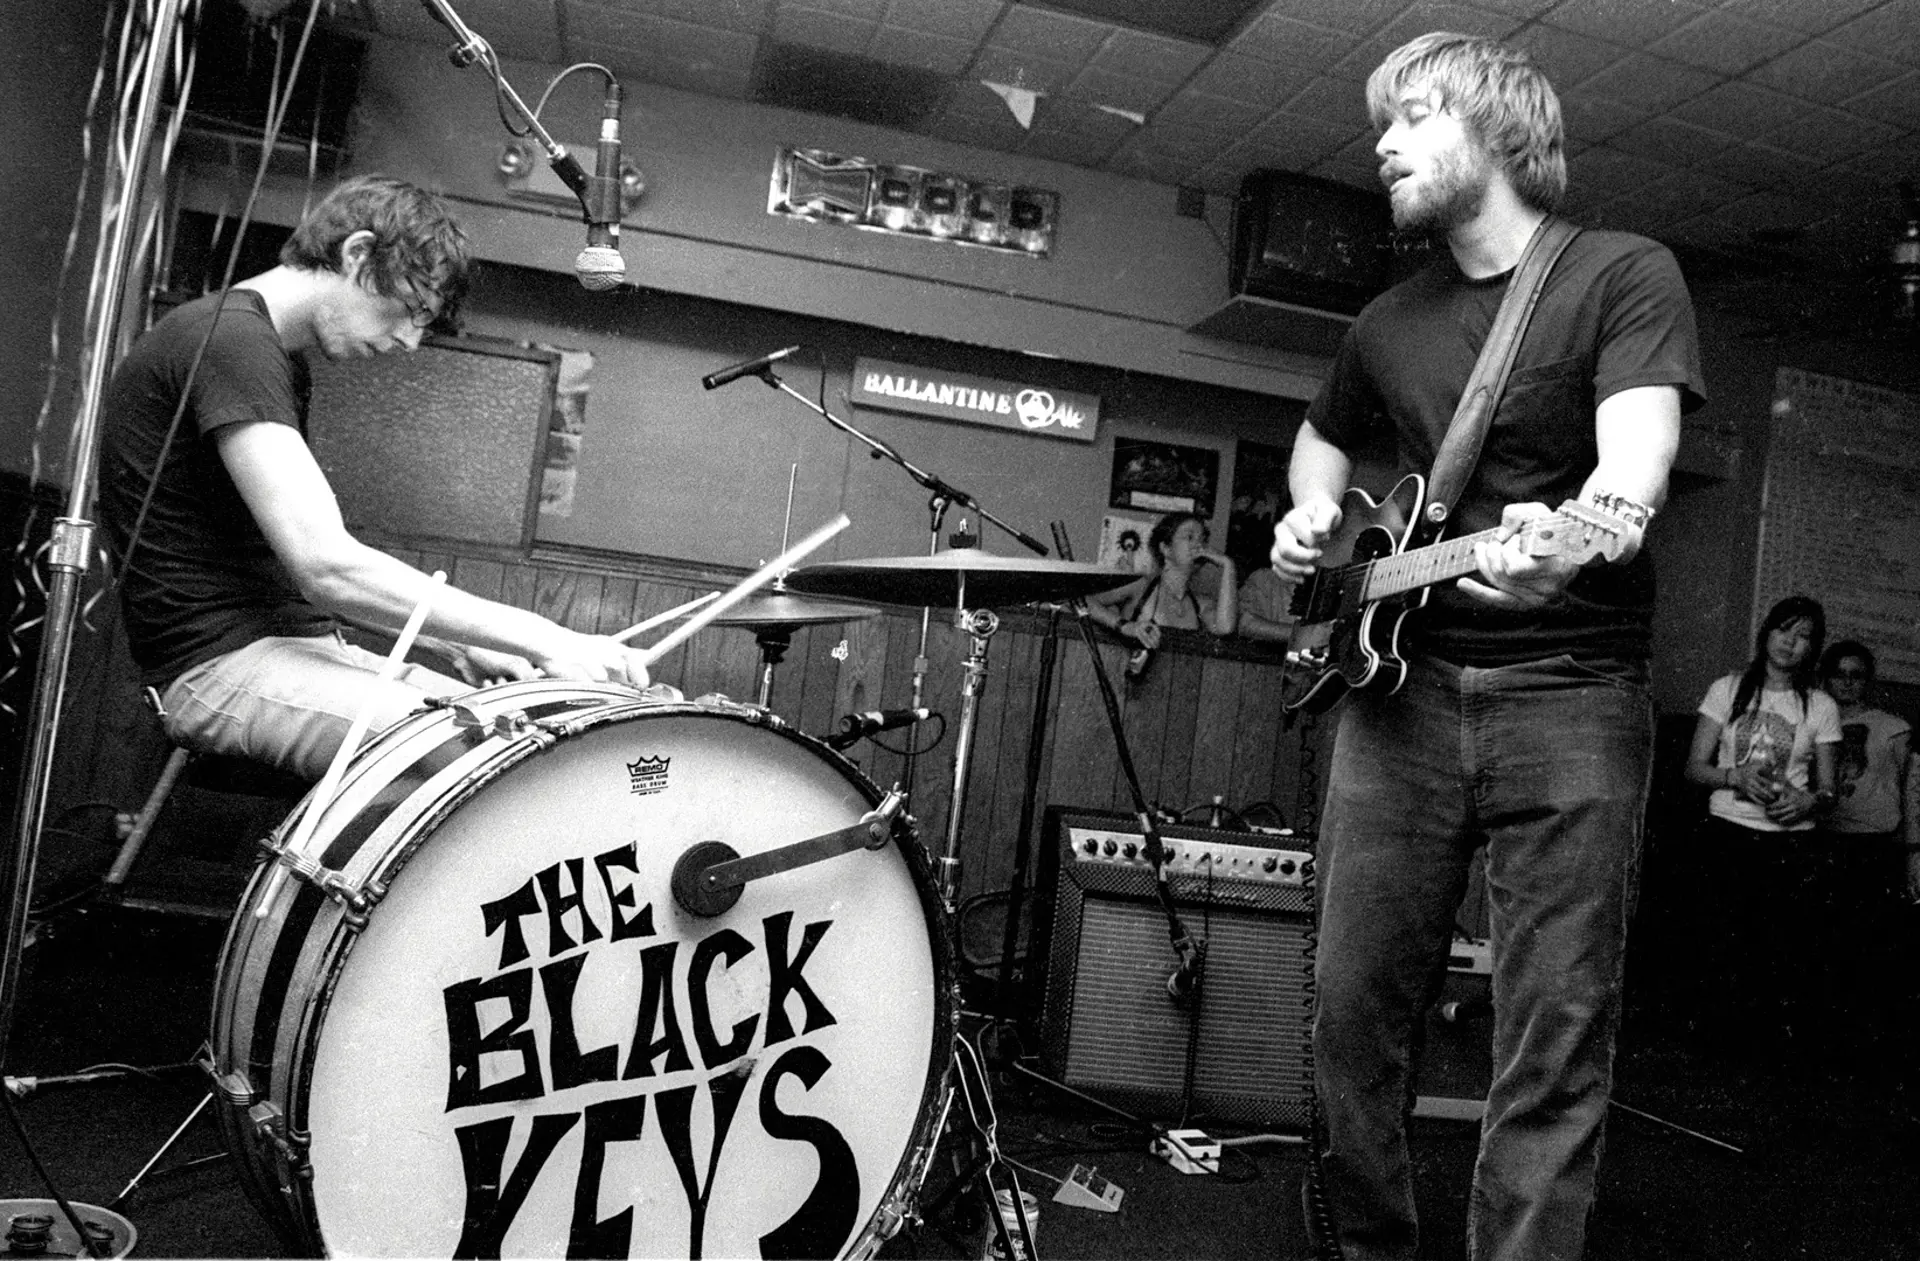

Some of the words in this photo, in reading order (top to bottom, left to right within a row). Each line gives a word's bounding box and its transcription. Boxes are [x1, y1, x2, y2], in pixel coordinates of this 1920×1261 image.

[864, 373, 1011, 414] BALLANTINE
[634, 764, 663, 773] REMO
[480, 840, 657, 970] THE
[443, 911, 837, 1114] BLACK
[452, 1045, 860, 1260] KEYS
